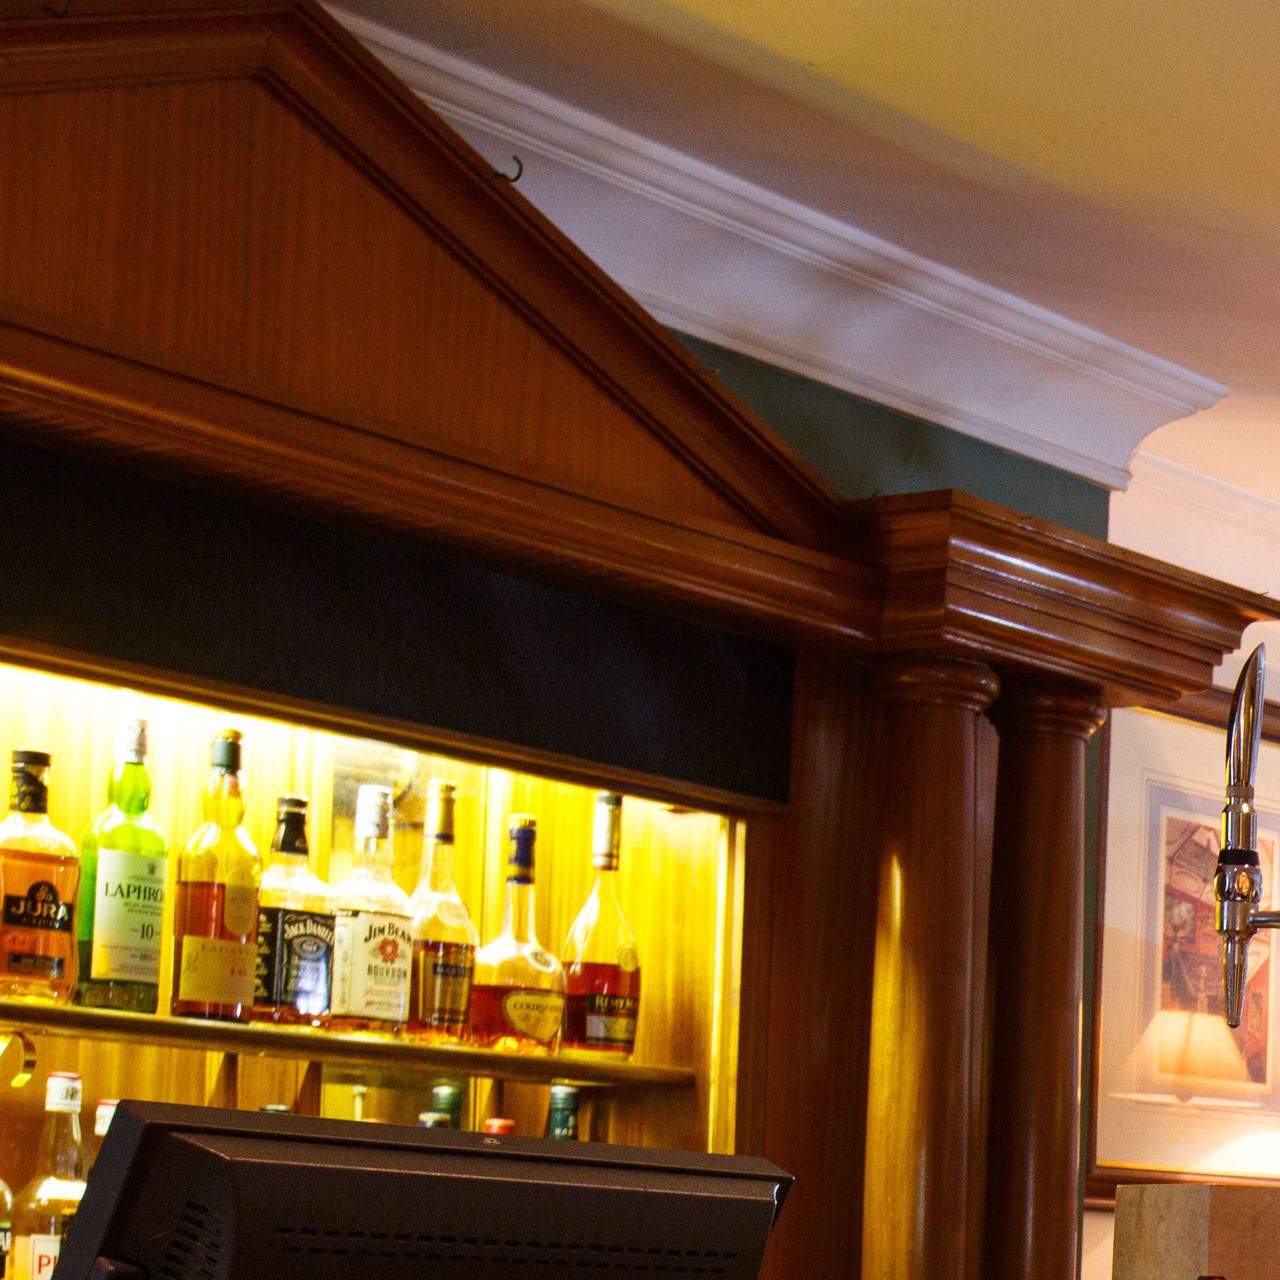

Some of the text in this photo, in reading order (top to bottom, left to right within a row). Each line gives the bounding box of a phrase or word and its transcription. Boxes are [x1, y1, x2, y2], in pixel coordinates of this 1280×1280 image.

[10, 899, 68, 921] JURA
[140, 923, 154, 940] 10
[364, 924, 385, 943] JIM
